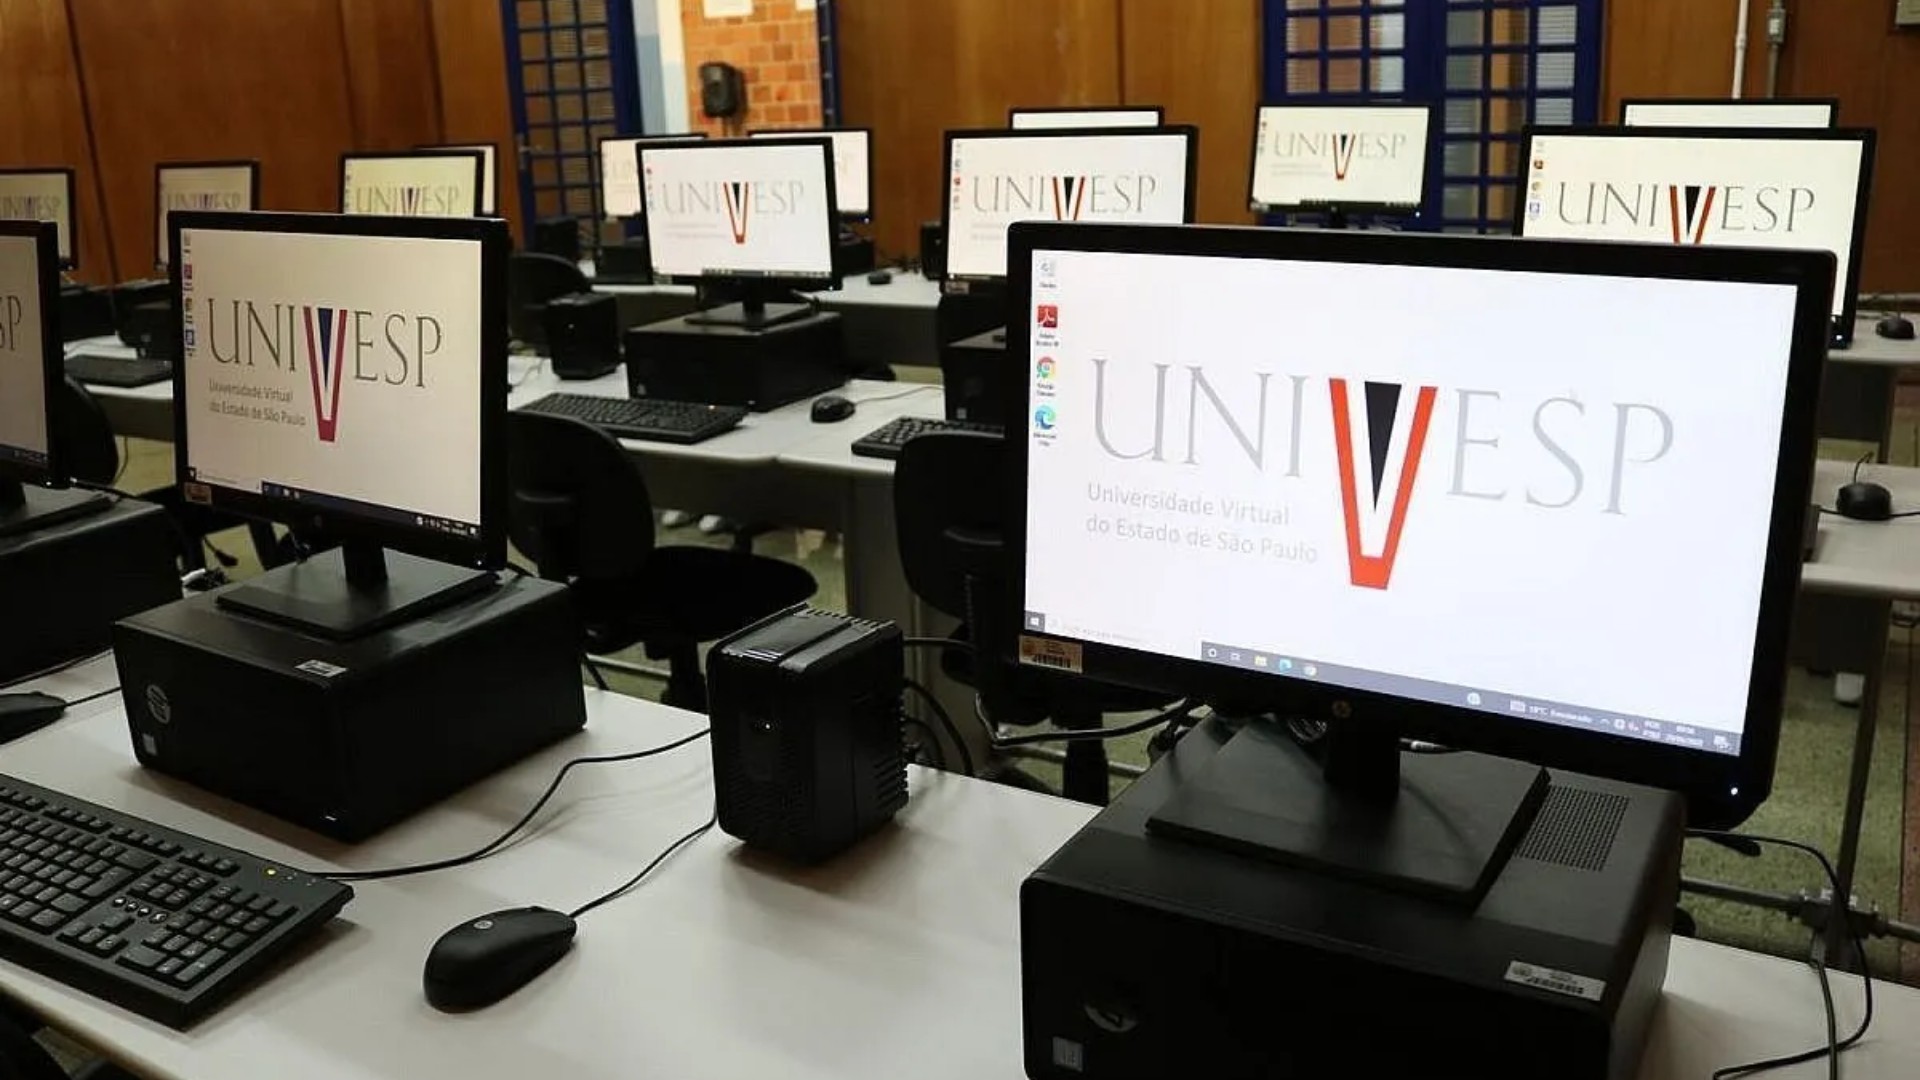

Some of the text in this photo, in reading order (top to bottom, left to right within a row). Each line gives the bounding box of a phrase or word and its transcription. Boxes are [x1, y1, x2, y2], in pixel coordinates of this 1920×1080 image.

[1273, 130, 1407, 180] UNIVESP
[662, 180, 805, 244] UNIVESP
[972, 174, 1156, 221] UNIVESP
[1557, 181, 1815, 245] UNIVESP
[208, 298, 442, 442] UNIVESP
[1091, 358, 1674, 590] UNIVESP
[1087, 483, 1289, 525] Universidade Virtual
[1086, 513, 1318, 564] do Estado de São Paulo
